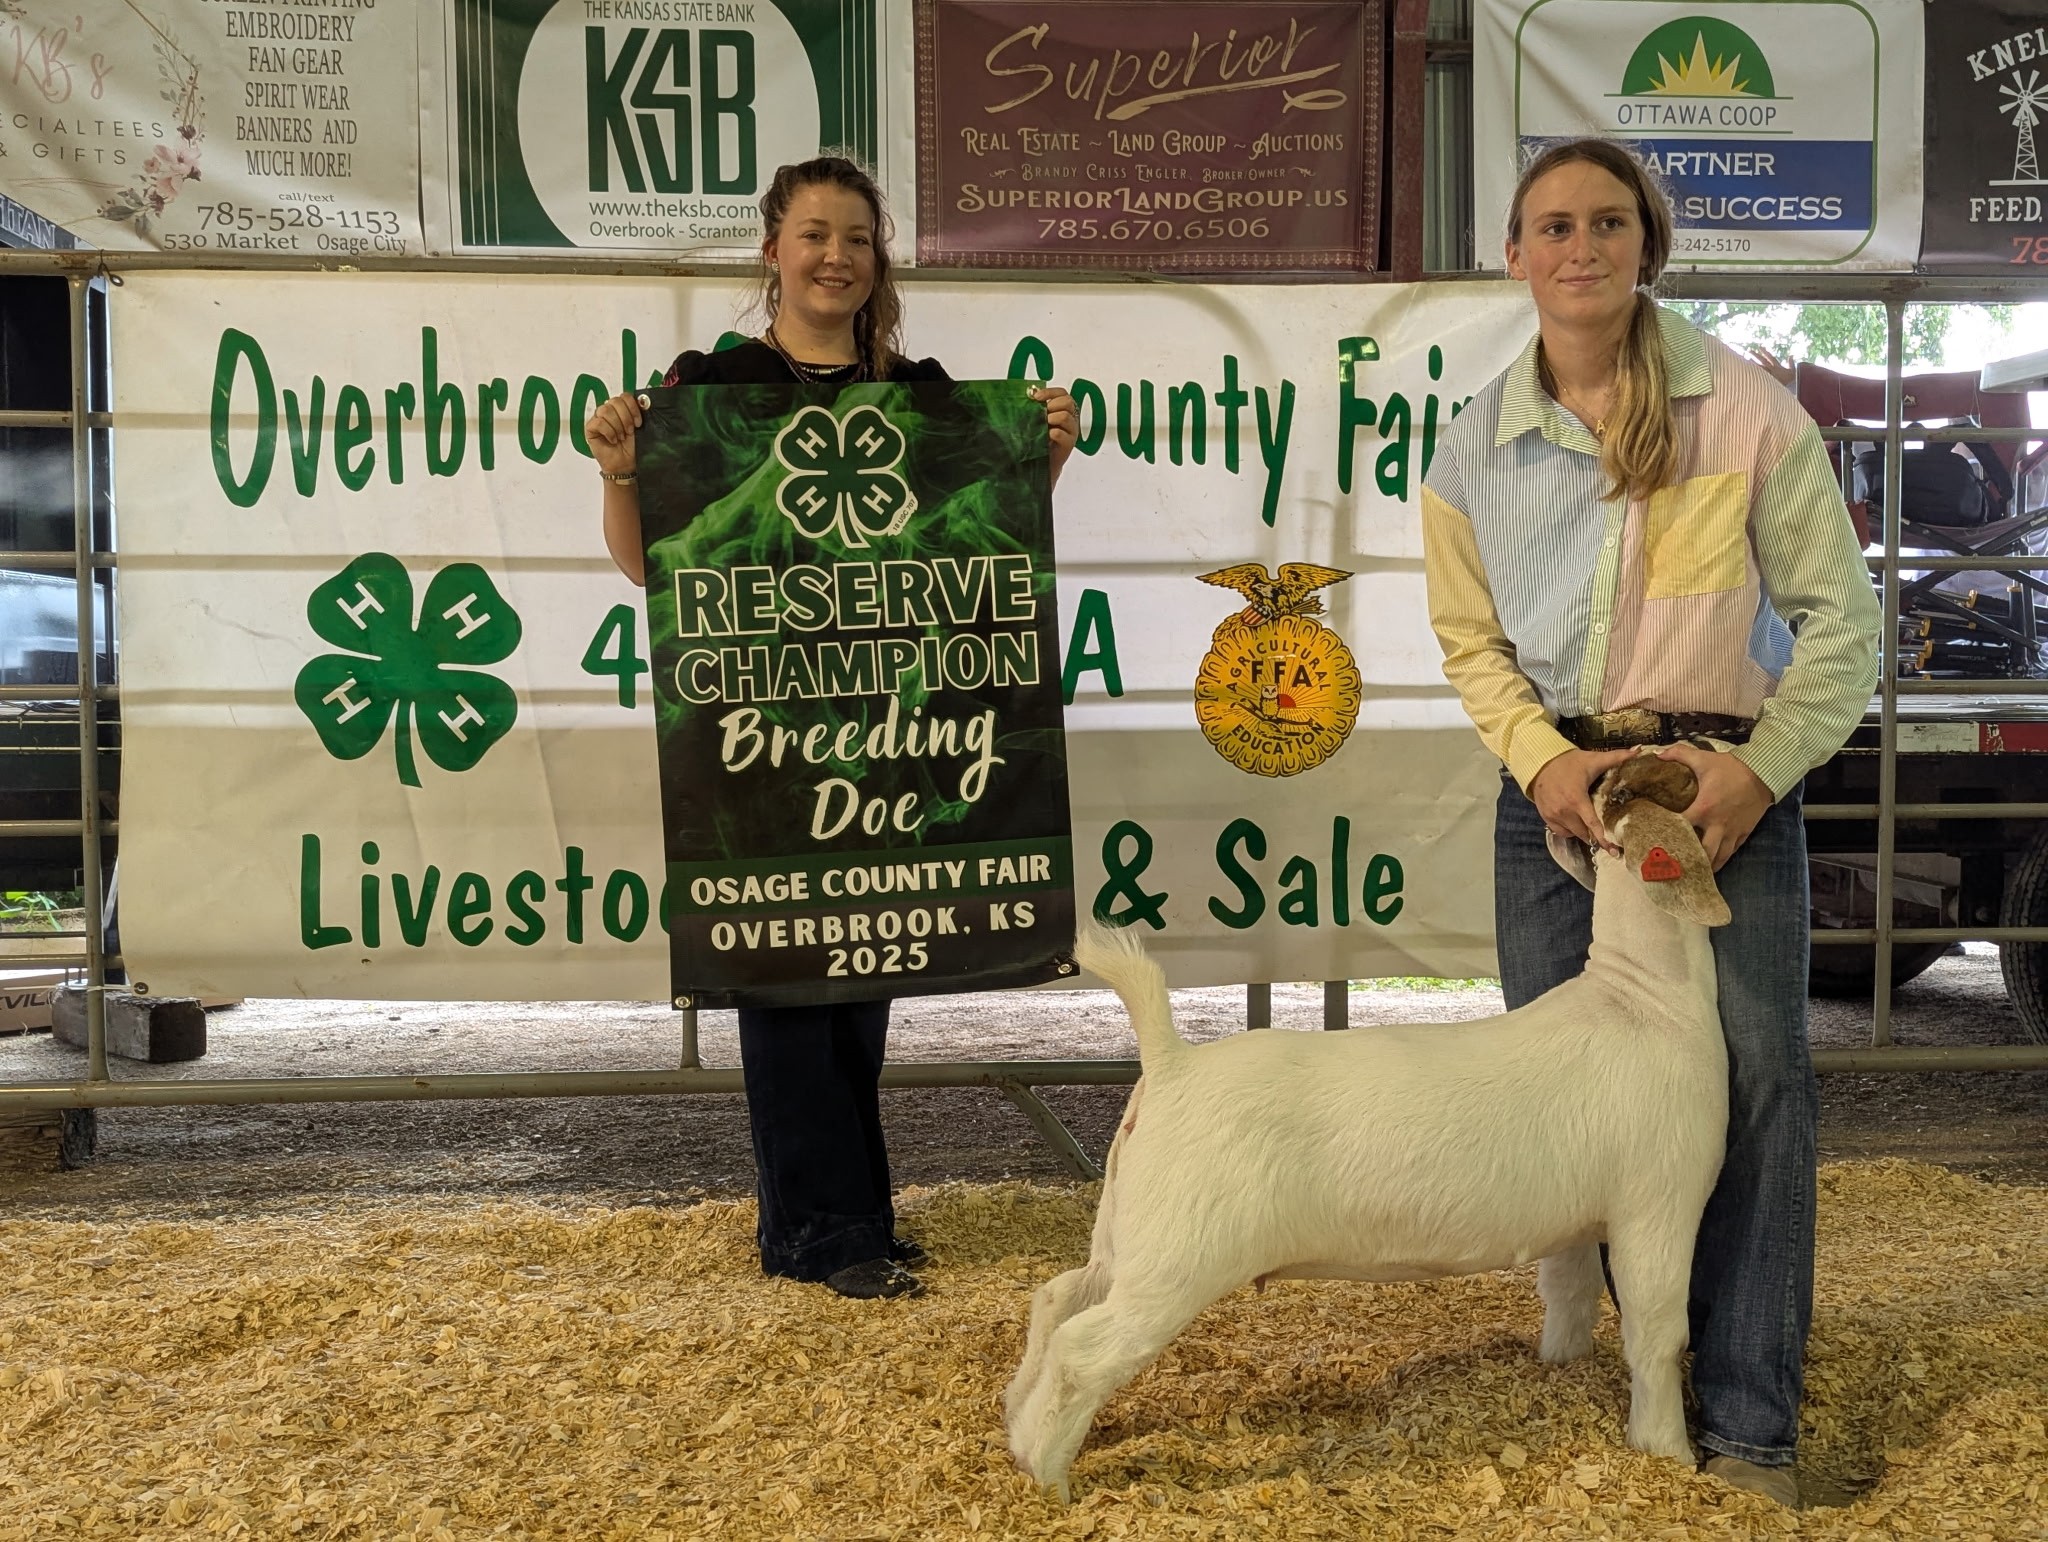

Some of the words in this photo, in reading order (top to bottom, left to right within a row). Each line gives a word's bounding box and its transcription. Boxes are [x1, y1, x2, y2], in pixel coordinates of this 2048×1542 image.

[226, 11, 355, 42] EMBROIDERY
[584, 1, 611, 20] THE
[614, 1, 671, 21] KANSAS
[673, 2, 713, 22] STATE
[716, 3, 755, 23] BANK
[249, 46, 286, 74] FAN
[292, 48, 344, 76] GEAR
[985, 17, 1318, 121] Superior
[245, 82, 298, 109] SPIRIT
[302, 85, 350, 111] WEAR
[585, 26, 758, 196] KSB
[0, 113, 164, 138] CIALTEES
[236, 115, 313, 144] BANNERS
[322, 119, 357, 145] AND
[1617, 103, 1713, 126] OTTAWA
[1719, 105, 1777, 127] COOP
[33, 143, 126, 165] GIFTS
[246, 149, 295, 177] MUCH
[299, 152, 352, 178] MORE!
[1637, 152, 1775, 177] ARTNER
[279, 192, 335, 203] call/text
[589, 198, 758, 220] www.theksb.com
[1684, 196, 1842, 221] SUCCESS
[1969, 196, 2043, 223] FEED,
[197, 202, 400, 234] 785-528-1153
[590, 221, 675, 239] Overbrook
[689, 223, 758, 239] Scranton
[1038, 218, 1270, 241] 785.670.6506
[164, 234, 207, 250] 530
[216, 233, 299, 250] Market
[317, 234, 368, 256] Osage
[374, 234, 407, 256] City
[1007, 335, 1296, 528] ounty
[1337, 336, 1474, 503] Fai
[674, 553, 1037, 638] RESERVE
[674, 630, 1040, 705] CHAMPION
[1226, 639, 1331, 694] AGRICULTURAL
[1251, 660, 1313, 688] FFA
[718, 695, 1006, 803] Breeding
[1231, 724, 1325, 755] EDUCATION
[809, 778, 925, 841] Doe
[301, 833, 668, 950] Livesto
[1092, 820, 1169, 931] &
[1208, 815, 1404, 930] Sale
[690, 871, 809, 907] OSAGE
[821, 860, 967, 898] COUNTY
[978, 854, 1051, 887] FAIR
[710, 906, 971, 952] OVERBROOK,
[989, 901, 1036, 932] KS
[826, 941, 929, 978] 2025
